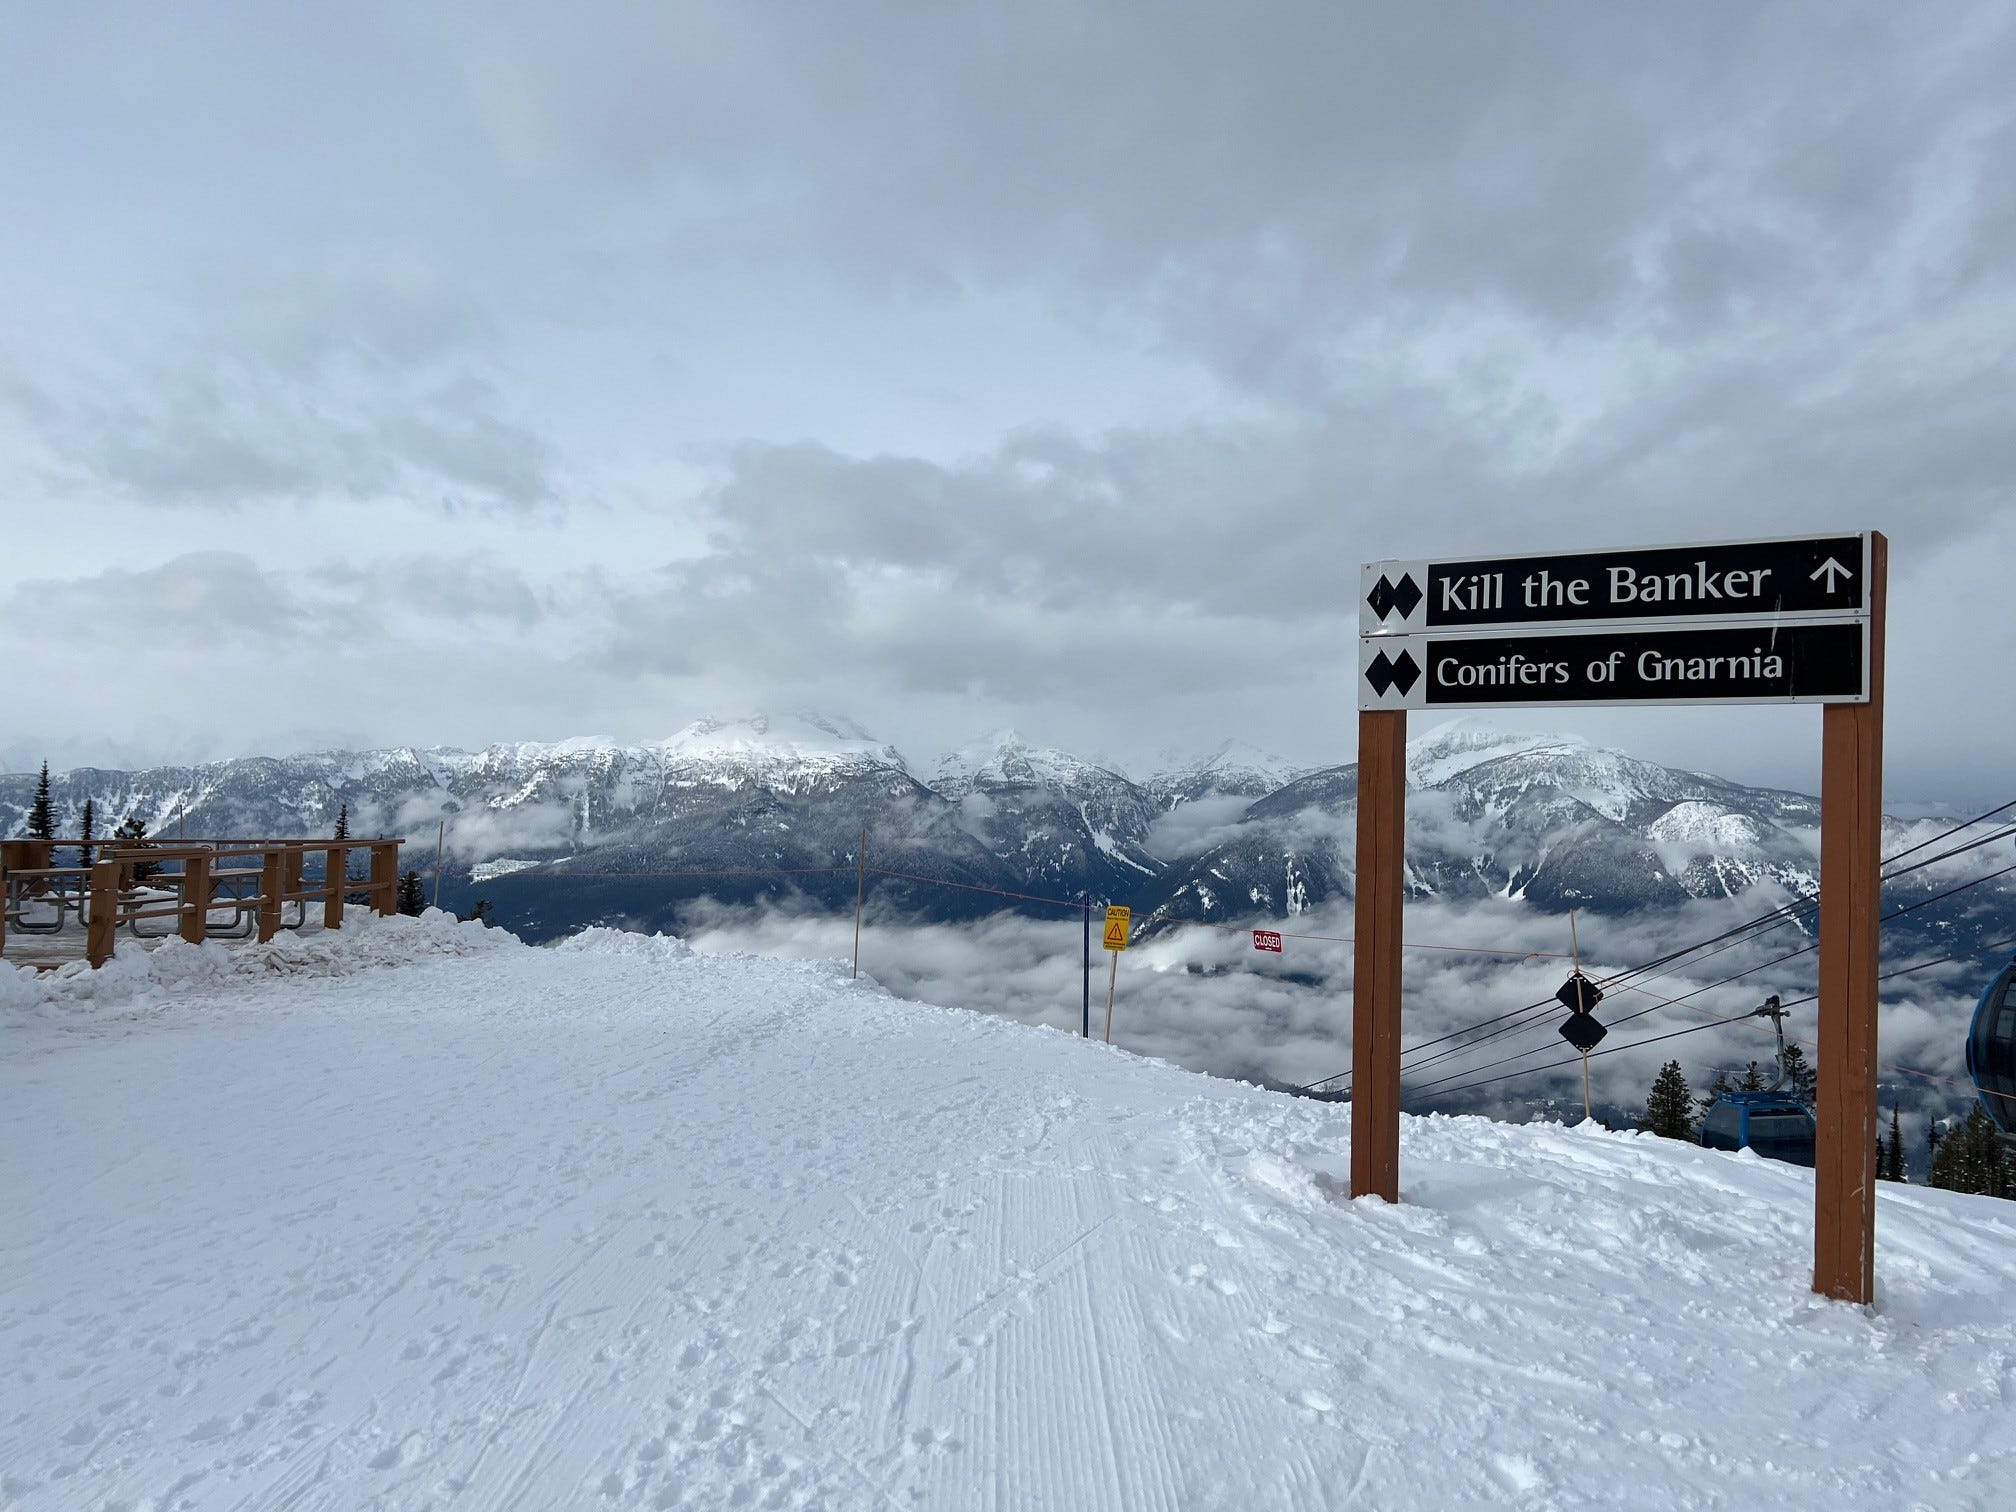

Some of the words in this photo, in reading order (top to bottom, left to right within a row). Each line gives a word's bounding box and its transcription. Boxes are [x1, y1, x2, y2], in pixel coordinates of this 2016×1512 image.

[1439, 572, 1503, 611] Kill
[1522, 571, 1590, 608] the
[1606, 561, 1772, 603] Banker
[1437, 654, 1569, 687] Conifers
[1587, 651, 1625, 683] of
[1637, 647, 1783, 681] Gnarnia
[1107, 908, 1129, 917] CAUTION
[1254, 934, 1280, 948] CLOSED
